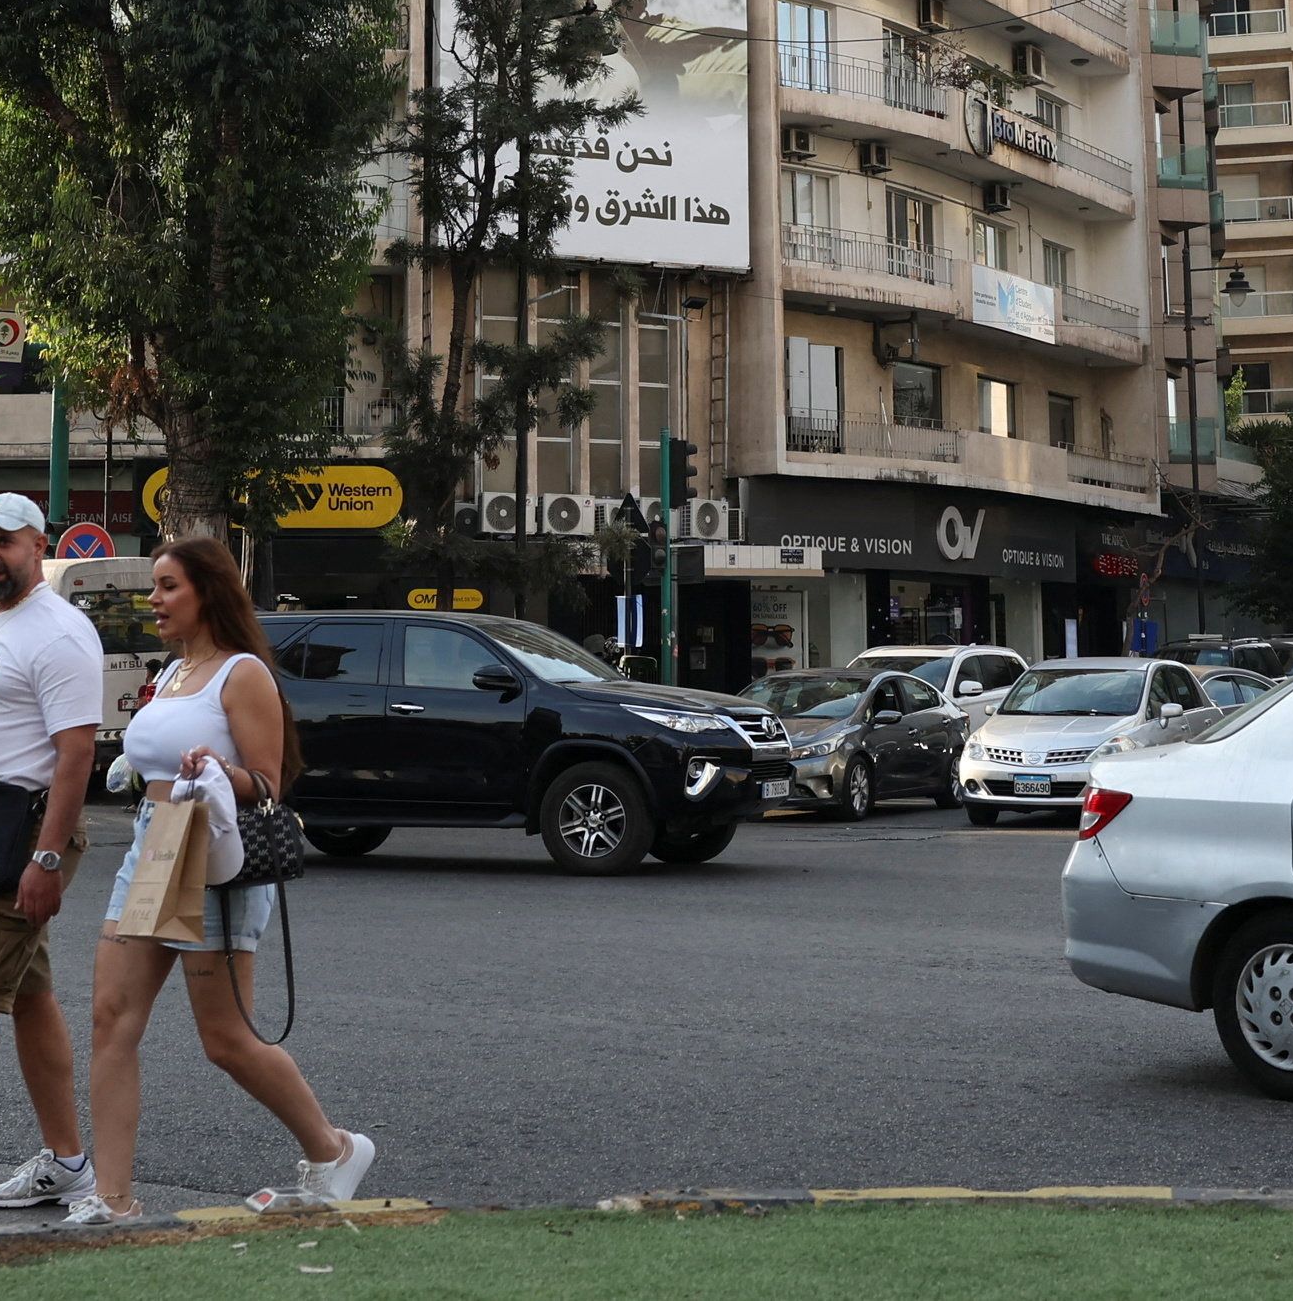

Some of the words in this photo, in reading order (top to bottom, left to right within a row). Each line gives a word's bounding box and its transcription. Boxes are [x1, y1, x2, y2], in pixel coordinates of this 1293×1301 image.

[993, 113, 1058, 162] BioMatrix
[616, 141, 673, 173] نحن
[595, 188, 676, 226] الشرق
[684, 197, 730, 225] هذا
[328, 483, 392, 497] Western
[328, 497, 374, 511] Union
[780, 534, 846, 553] OPTIQUE
[850, 537, 860, 553] &
[864, 538, 912, 555] VISION
[1002, 548, 1032, 566] OPTIQUE
[1033, 551, 1040, 566] &
[1041, 551, 1065, 569] VISION
[772, 603, 787, 612] OFF
[110, 660, 143, 670] MITSU
[1015, 782, 1050, 793] G366490
